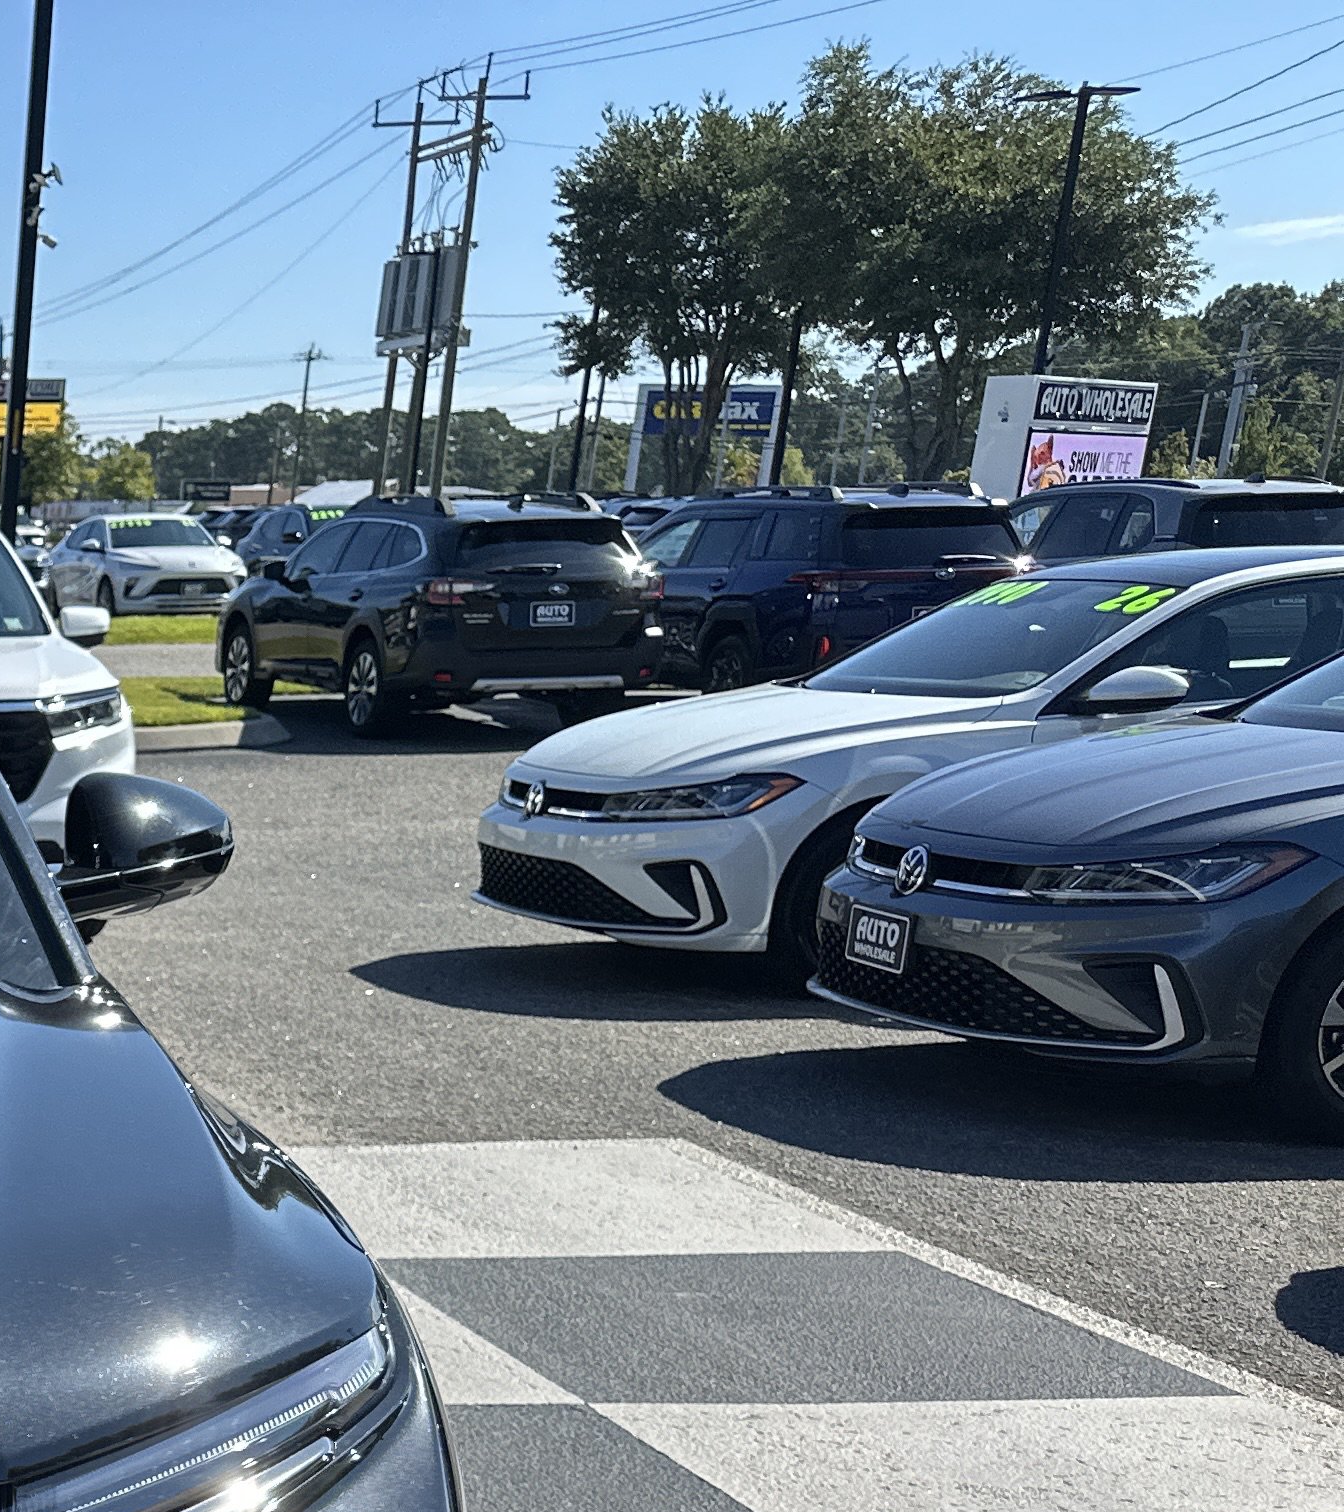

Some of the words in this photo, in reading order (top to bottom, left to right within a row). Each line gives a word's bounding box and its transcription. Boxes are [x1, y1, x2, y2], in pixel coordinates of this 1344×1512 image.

[1040, 386, 1078, 415] AUTO
[1082, 388, 1152, 419] WHOLESALE
[1069, 451, 1100, 473] SHOW
[1100, 452, 1114, 473] ME
[1115, 453, 1132, 474] THE
[536, 604, 569, 616] AUTO
[1094, 585, 1176, 614] 26
[856, 915, 900, 947] AUTO
[854, 941, 896, 964] WHOLESALE
